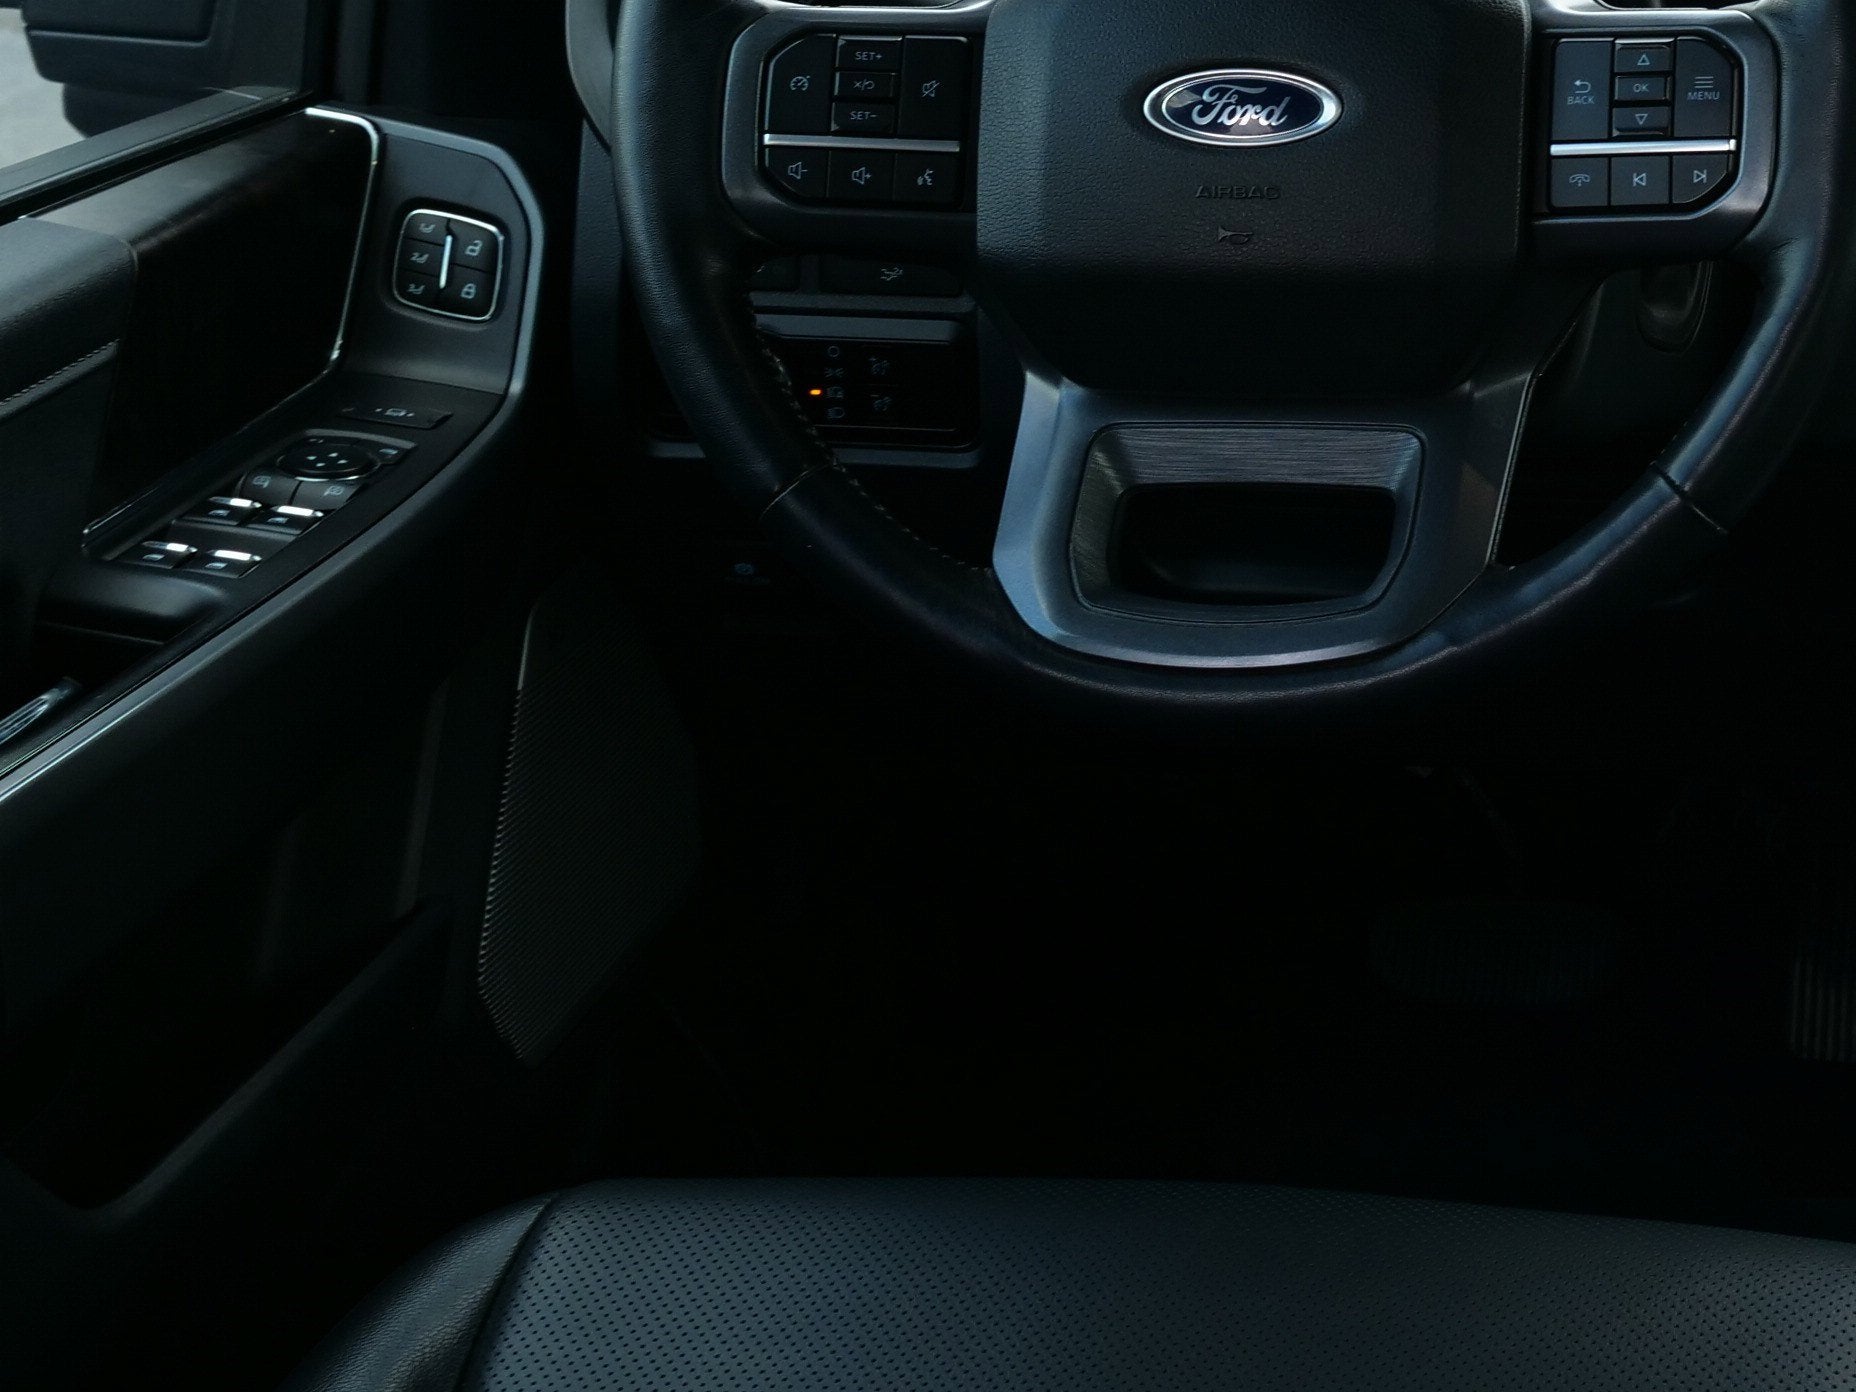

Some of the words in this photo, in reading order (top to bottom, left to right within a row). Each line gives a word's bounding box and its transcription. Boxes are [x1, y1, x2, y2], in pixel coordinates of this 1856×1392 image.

[1633, 83, 1649, 93] OK
[1567, 95, 1595, 105] BACK
[1687, 91, 1721, 101] MENU
[1191, 83, 1292, 126] Ford
[1195, 185, 1281, 200] AIRBAG
